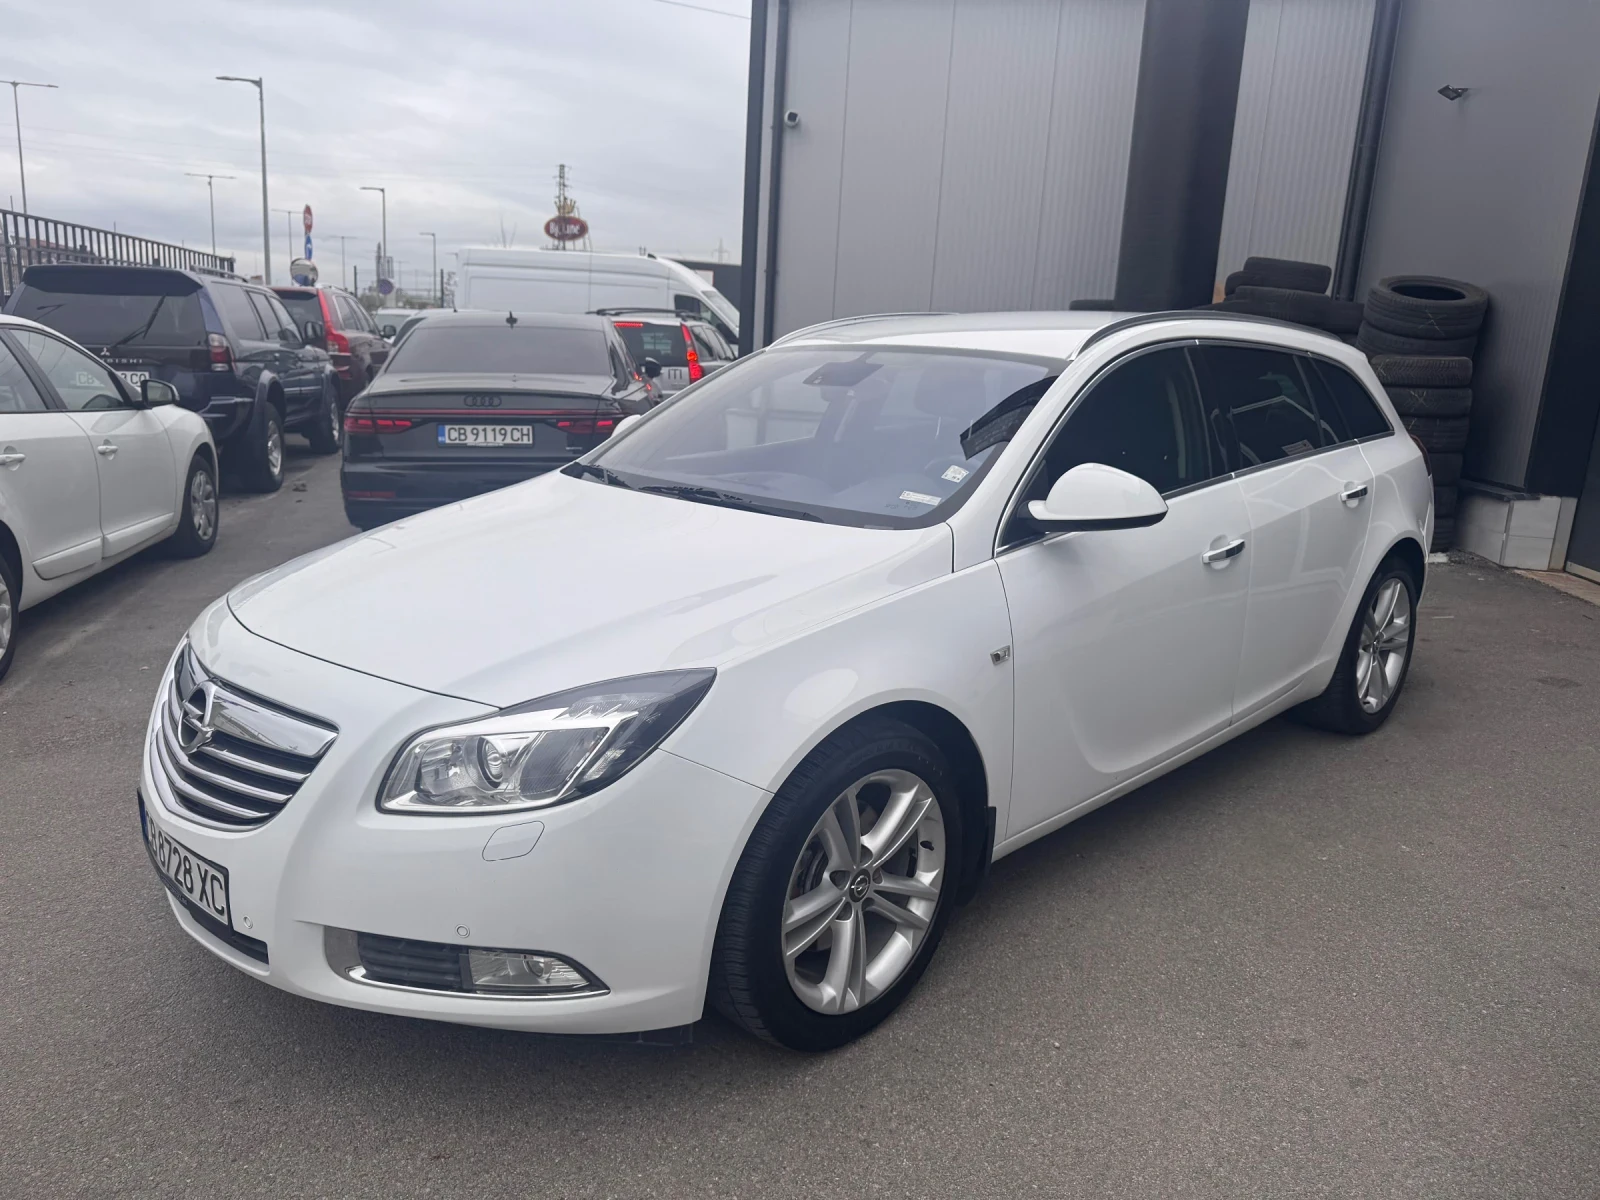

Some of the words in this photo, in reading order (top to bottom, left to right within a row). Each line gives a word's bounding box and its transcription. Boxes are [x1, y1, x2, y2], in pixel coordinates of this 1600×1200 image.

[447, 427, 468, 442] CB
[470, 427, 508, 442] 9119
[510, 427, 531, 442] CH
[158, 830, 194, 895] 8728
[196, 863, 225, 916] XC
